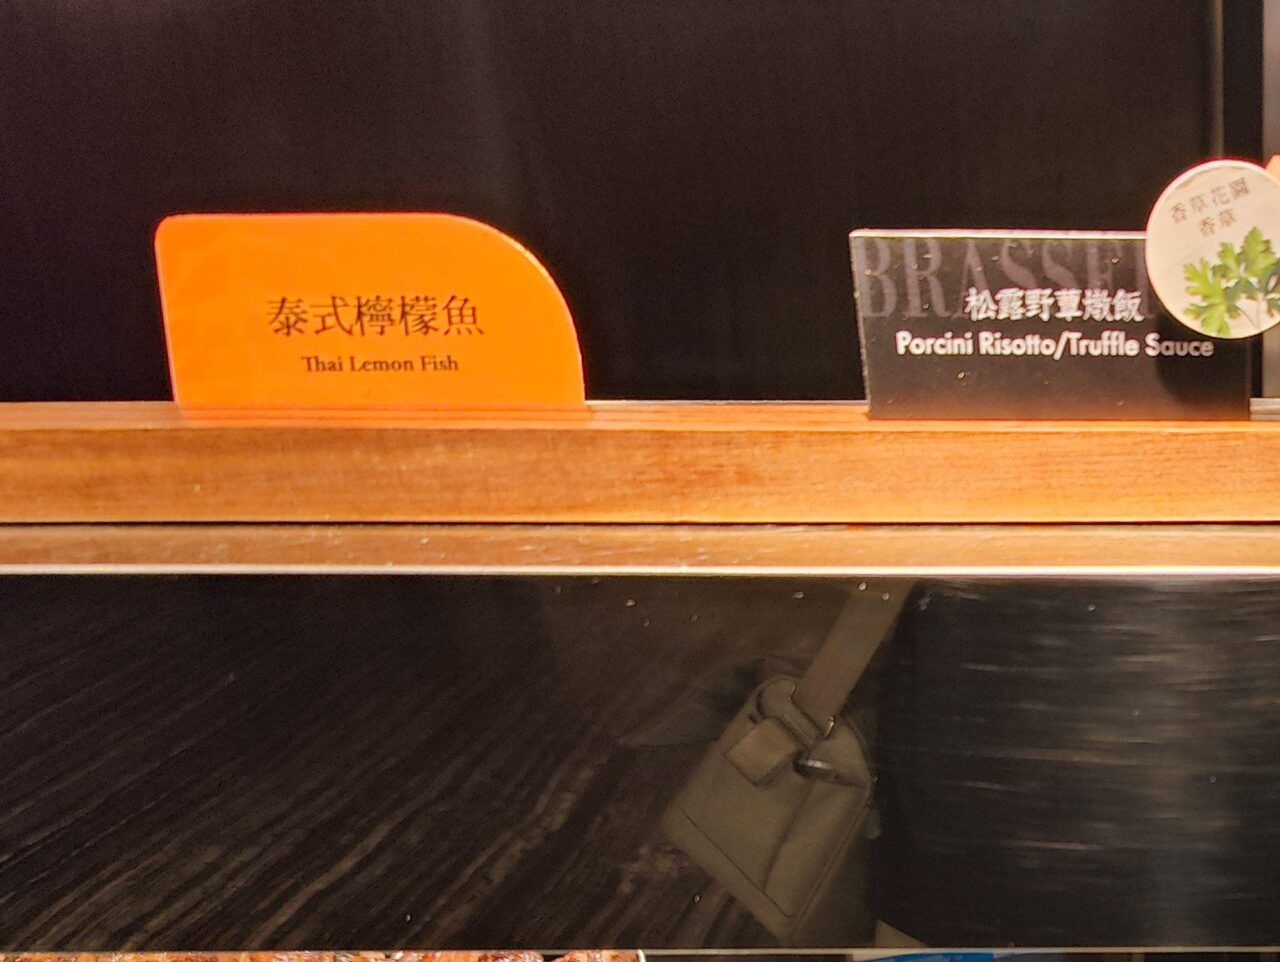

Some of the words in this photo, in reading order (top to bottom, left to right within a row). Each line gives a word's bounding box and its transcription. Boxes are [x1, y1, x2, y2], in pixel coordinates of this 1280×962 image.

[267, 295, 485, 337] 泰式檸檬魚
[895, 331, 973, 357] Porcini
[978, 331, 1140, 361] Risotto/Truffle
[1144, 333, 1214, 357] Sauce
[301, 355, 344, 373] Thai
[350, 355, 414, 374] Lemon
[420, 355, 459, 373] Fish
